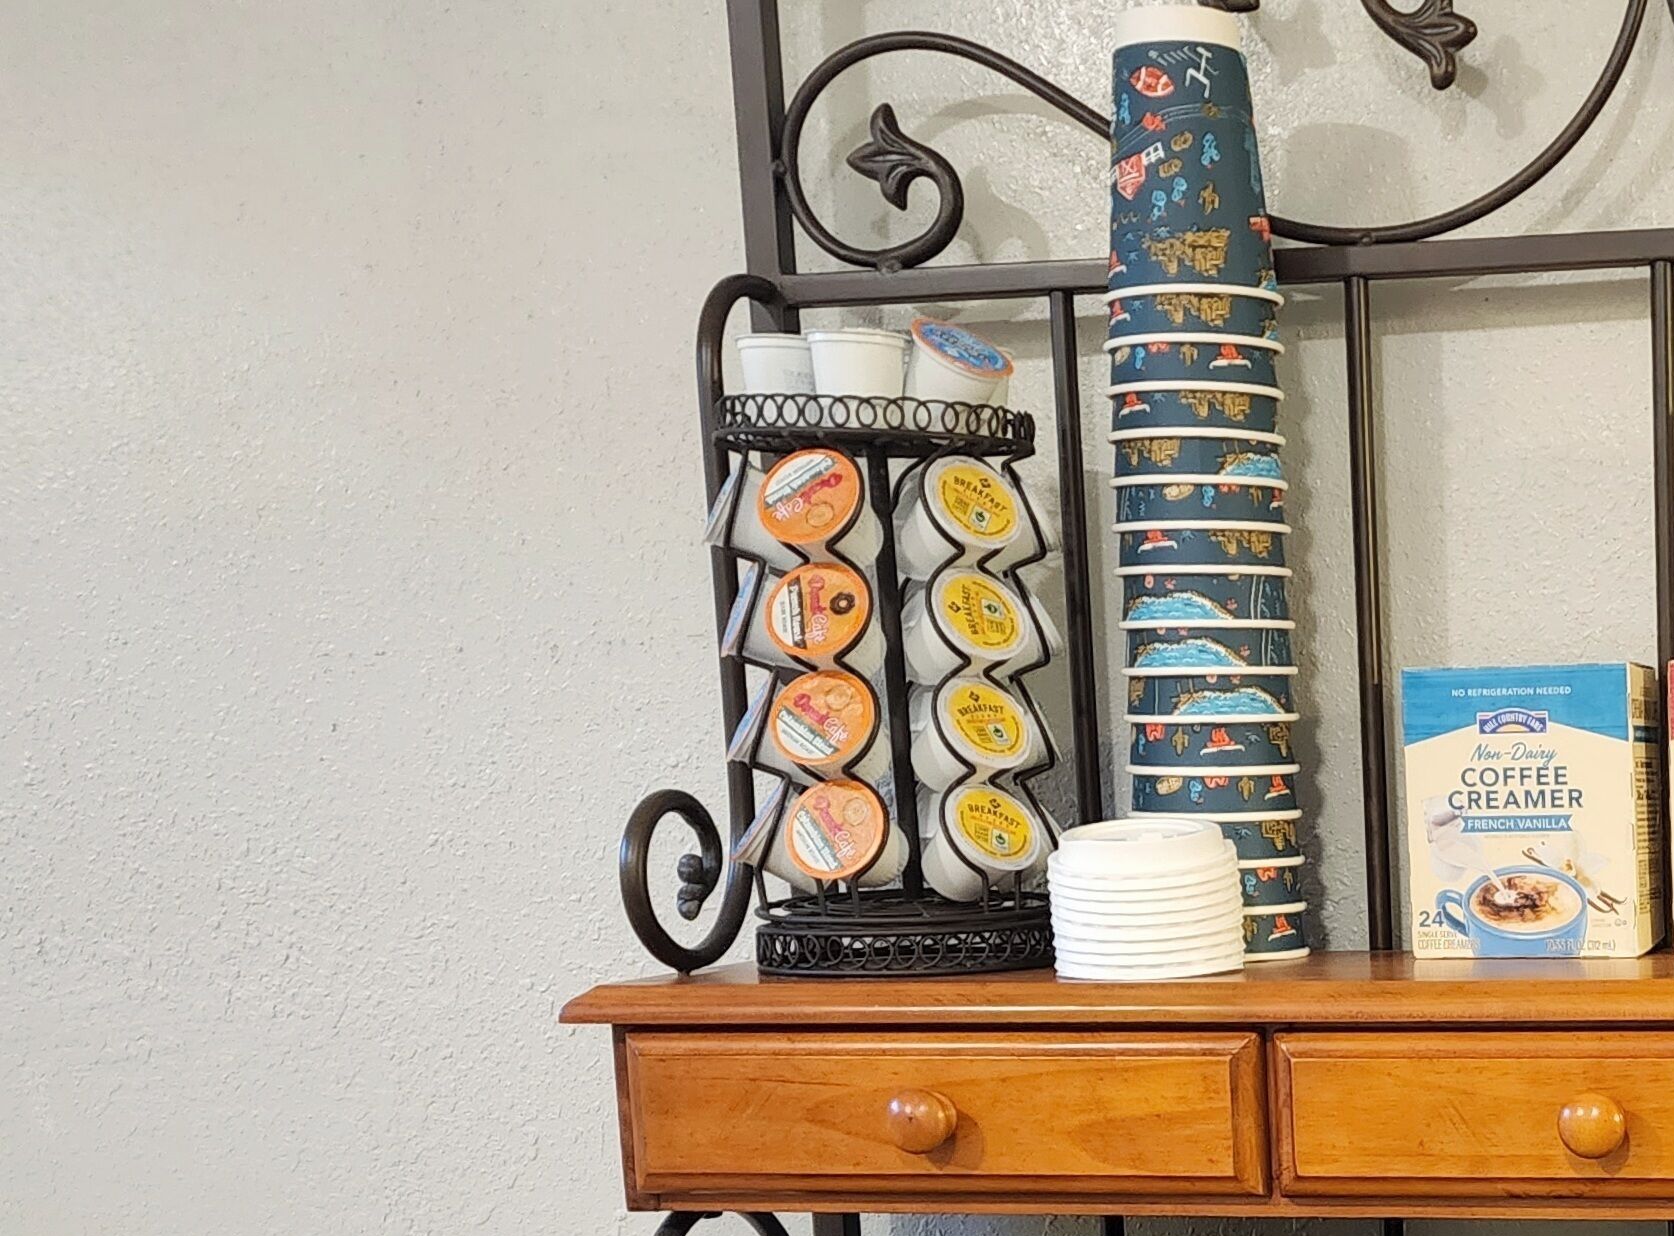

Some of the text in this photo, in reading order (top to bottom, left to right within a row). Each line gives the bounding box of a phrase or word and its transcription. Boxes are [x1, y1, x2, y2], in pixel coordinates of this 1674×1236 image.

[954, 475, 1008, 512] BREAKFAST
[961, 584, 980, 635] BREAKFAST
[1451, 685, 1572, 697] NO REFRIGERATION NEEDED
[957, 704, 1004, 717] BREAKFAST
[1470, 742, 1557, 767] Non-Dairy
[1460, 766, 1568, 788] COFFEE
[1447, 789, 1584, 810] CREAMER
[968, 803, 1021, 829] BREAKFAST
[1467, 817, 1568, 830] FRENCH VANILLA
[1418, 910, 1444, 928] 24
[1417, 939, 1442, 950] COFFEE
